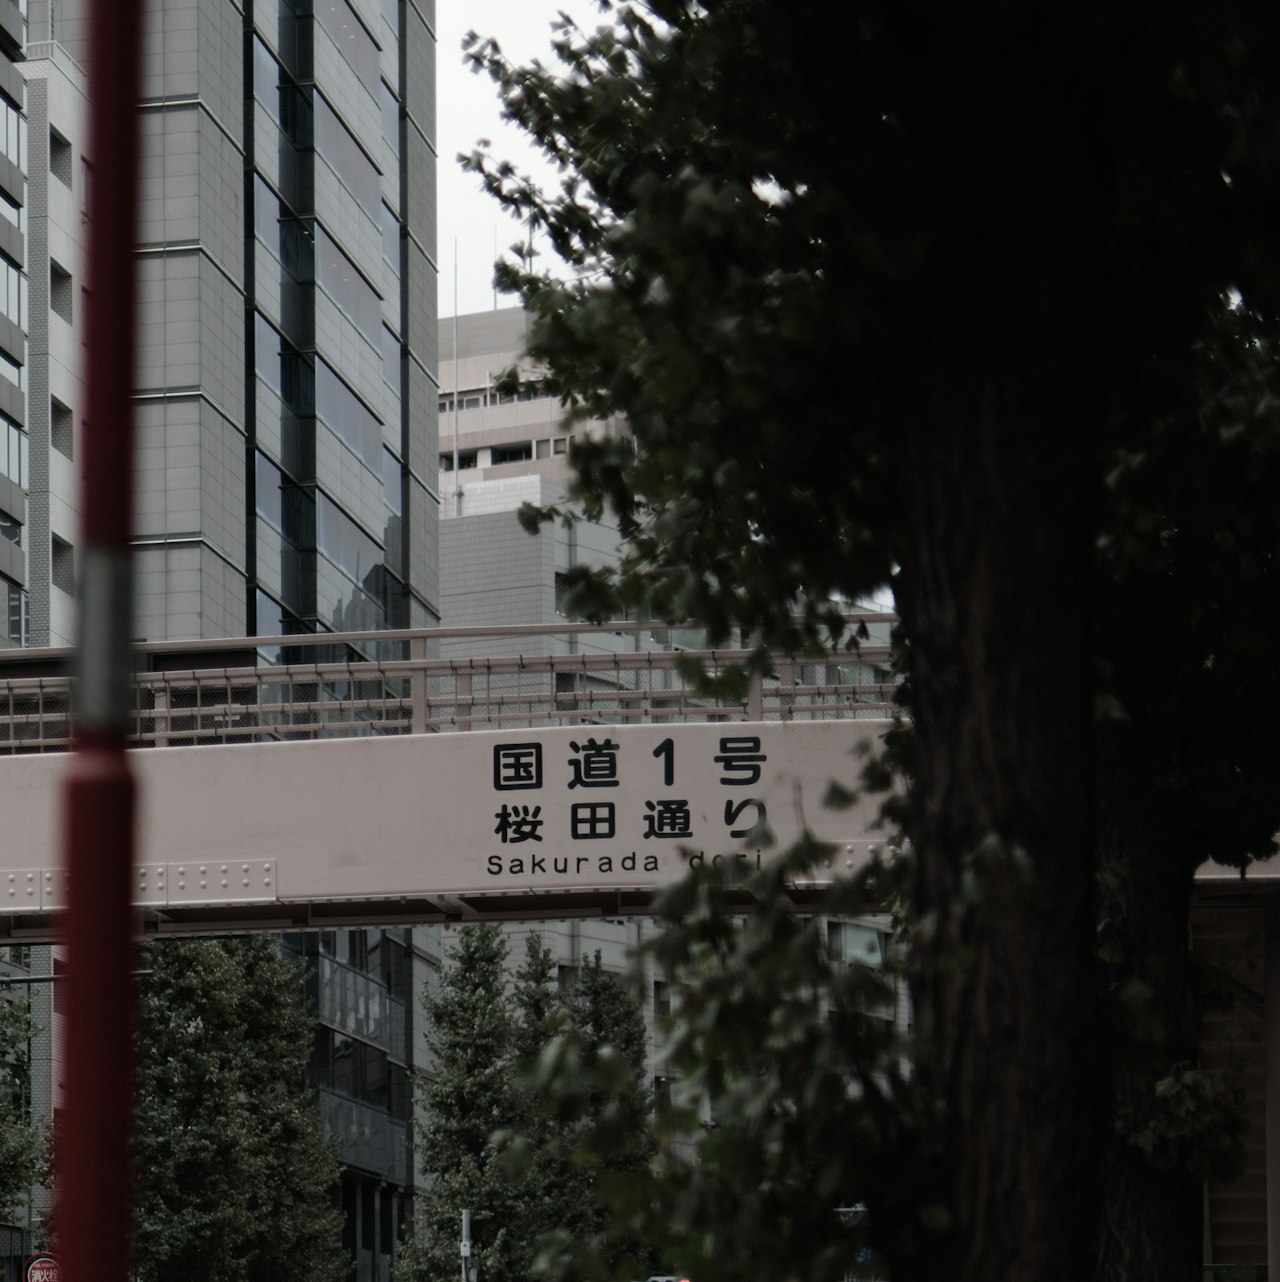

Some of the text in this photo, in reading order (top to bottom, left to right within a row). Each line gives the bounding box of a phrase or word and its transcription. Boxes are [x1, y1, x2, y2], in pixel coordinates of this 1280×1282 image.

[493, 736, 767, 791] 国道1号
[494, 798, 767, 844] 桜田通り
[487, 852, 659, 876] Sakurada
[31, 1268, 59, 1282] 消火栓
